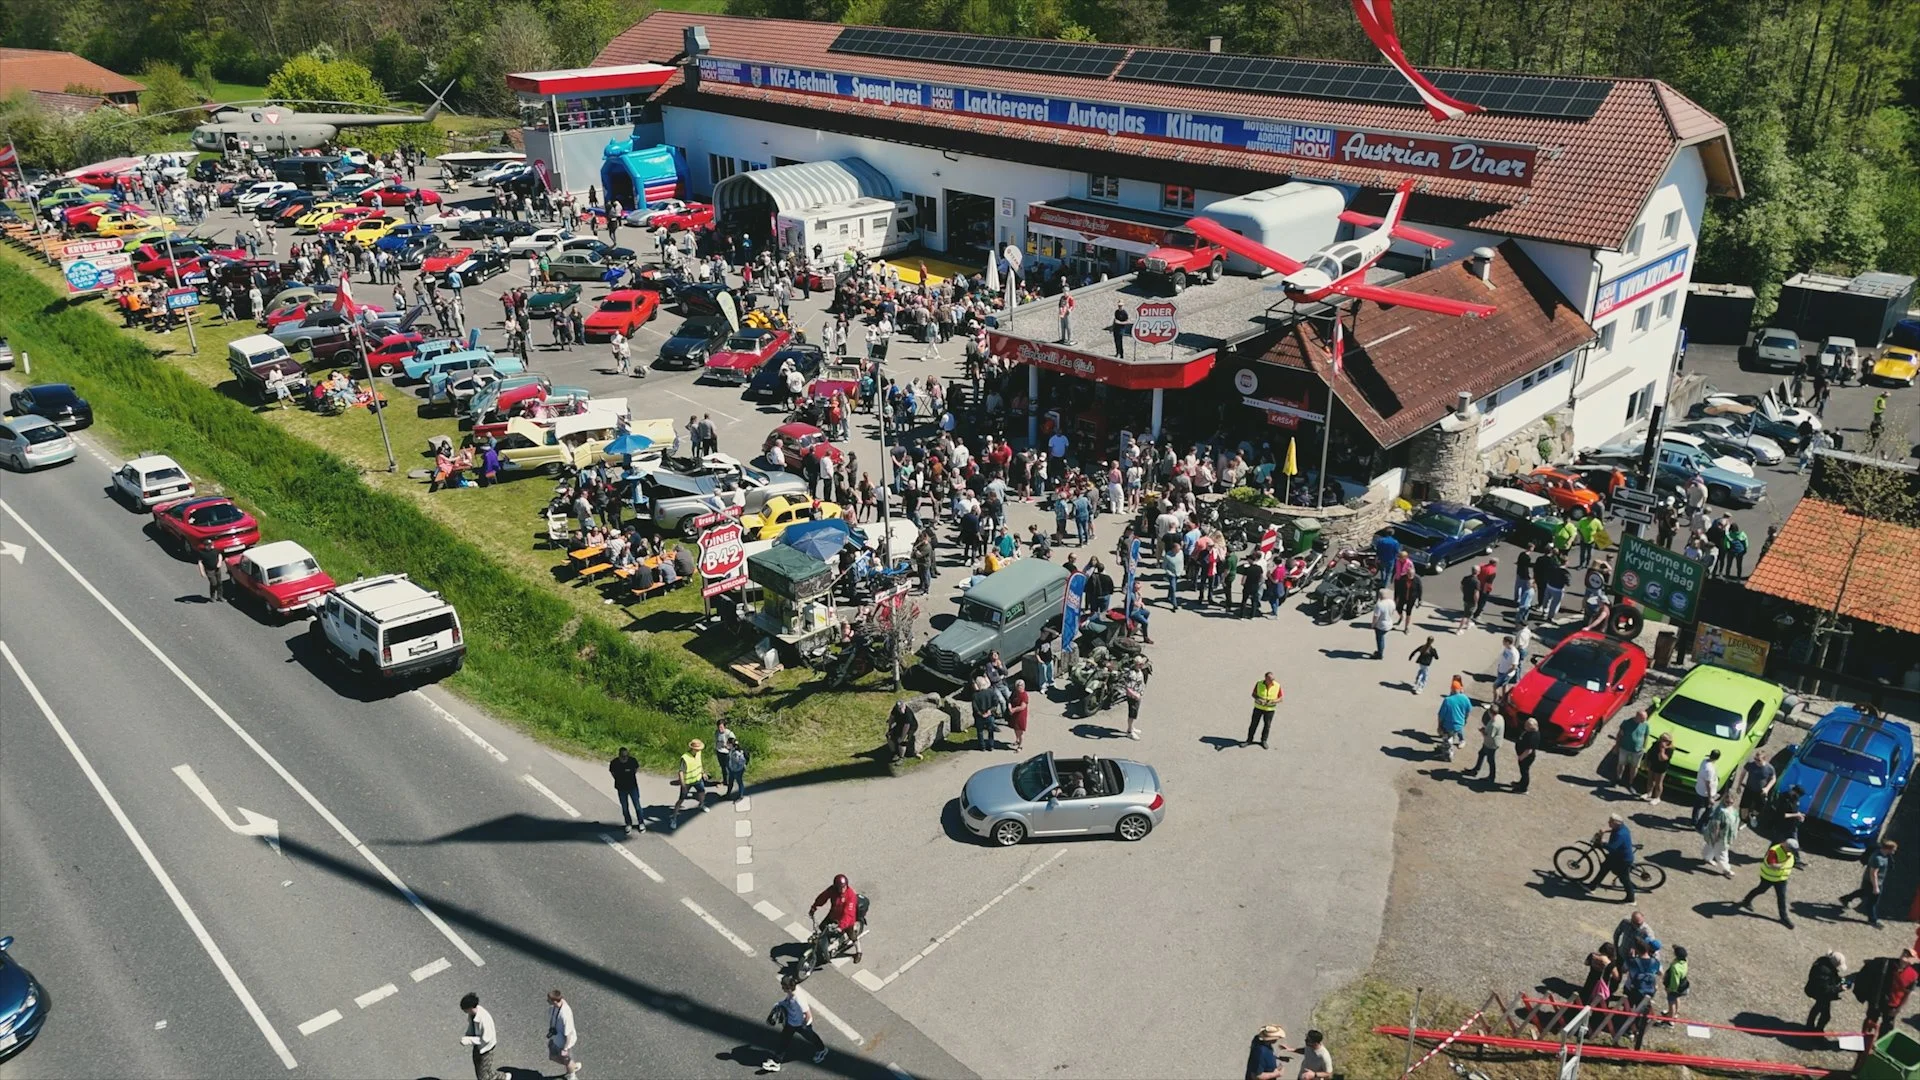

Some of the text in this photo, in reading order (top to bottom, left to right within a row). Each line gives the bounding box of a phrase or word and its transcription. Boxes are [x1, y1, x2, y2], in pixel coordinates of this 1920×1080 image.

[769, 67, 838, 94] KFZ-Technik
[852, 77, 921, 105] Spenglerei
[932, 87, 953, 99] LIQUI
[932, 98, 953, 110] MOLY
[964, 90, 1049, 121] Lackiererei
[1067, 102, 1146, 135] Autoglas
[1166, 113, 1224, 143] Klima
[1257, 132, 1292, 144] ADDITIVE
[1295, 126, 1331, 143] LIQUI
[1245, 141, 1291, 155] AUTOPFLEGE
[1293, 142, 1330, 158] MOLY
[1342, 132, 1527, 178] Austrian Diner
[1141, 308, 1172, 316] DINER
[1139, 321, 1172, 337] B42
[705, 530, 737, 547] DINER
[705, 545, 740, 571] B42
[1630, 540, 1694, 576] Welcome to
[1625, 551, 1654, 573] Krydl
[1664, 566, 1694, 591] Haag
